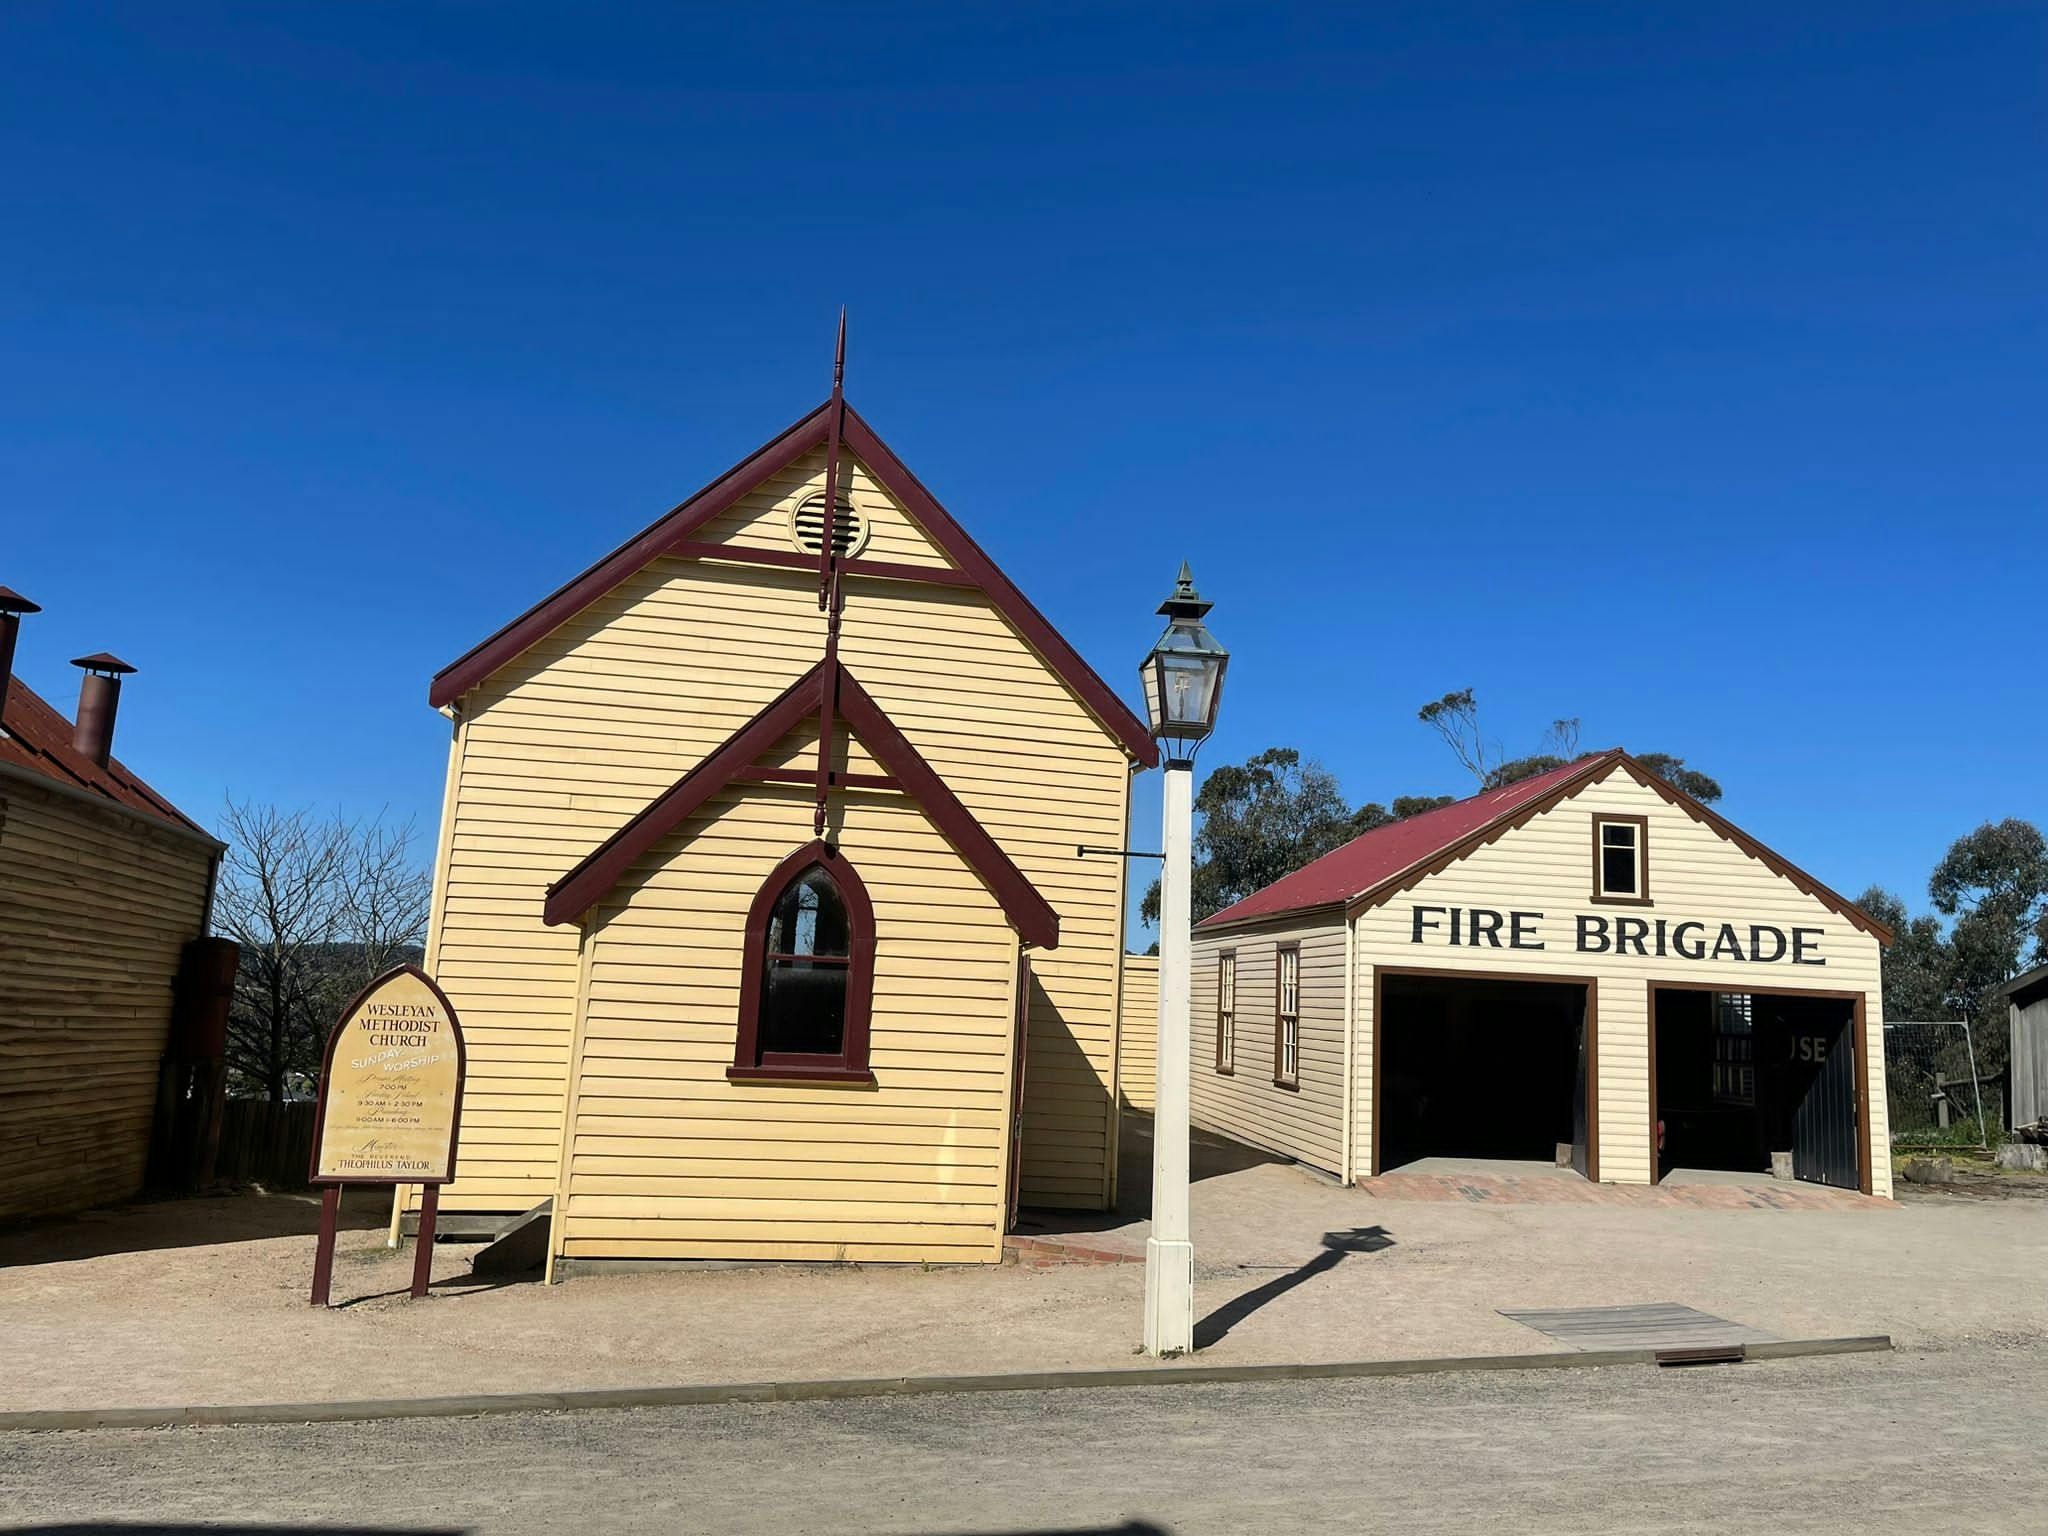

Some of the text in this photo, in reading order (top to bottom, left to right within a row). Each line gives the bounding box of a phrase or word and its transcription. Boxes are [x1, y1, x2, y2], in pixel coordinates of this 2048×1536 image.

[1411, 904, 1827, 967] FIRE BRIGADE
[367, 1003, 436, 1018] WESLEYAN
[360, 1018, 441, 1033] METHODIST
[369, 1033, 427, 1047] CHURCH
[383, 1055, 440, 1072] WORSHIP
[338, 1160, 430, 1170] THEOPHILUS TAYLOR
